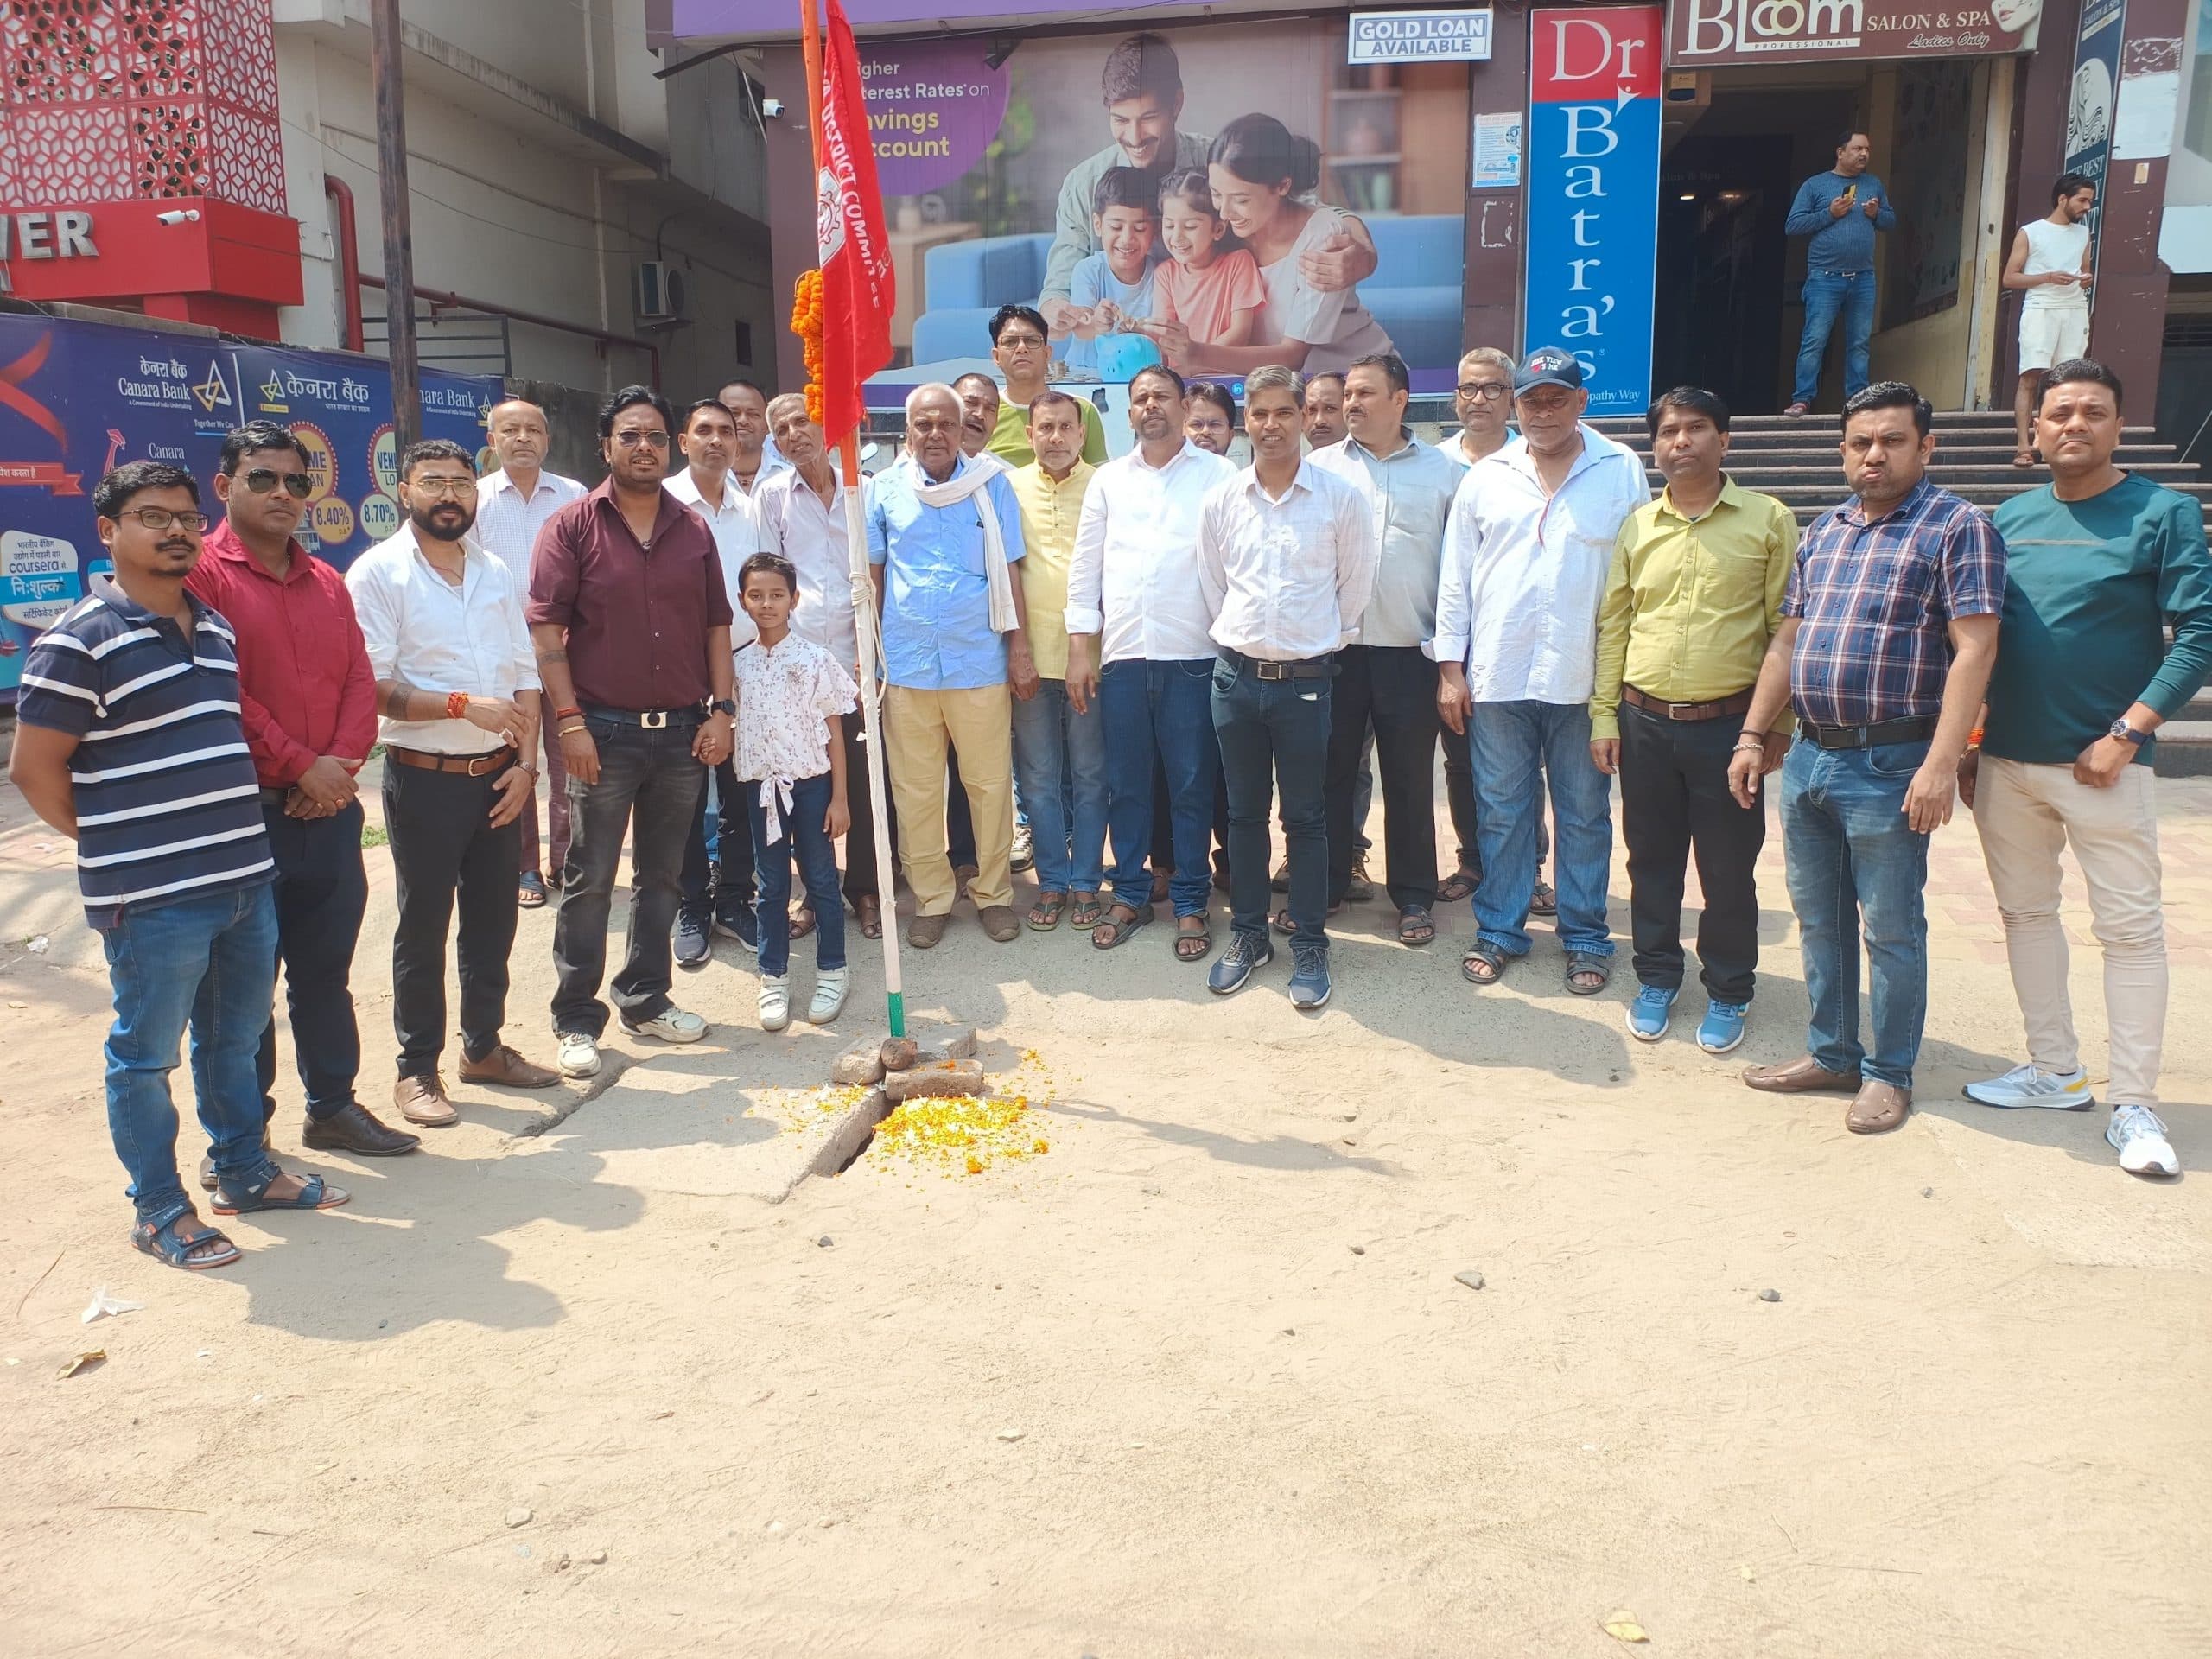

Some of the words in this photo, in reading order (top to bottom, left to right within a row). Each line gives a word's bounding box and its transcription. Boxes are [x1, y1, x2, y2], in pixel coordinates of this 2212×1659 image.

[1359, 21, 1421, 40] GOLD
[1427, 19, 1484, 38] LOAN
[1866, 13, 1931, 31] SALON
[1936, 13, 1951, 29] &
[1956, 10, 1991, 28] SPA
[1371, 39, 1472, 55] AVAILABLE
[1755, 40, 1850, 49] PROFESSIONAL
[1907, 33, 1954, 48] Ladies
[1957, 31, 1990, 48] Only
[969, 84, 990, 97] on
[2083, 154, 2106, 178] BEST
[140, 355, 169, 378] केनरा
[170, 359, 188, 379] बैंक
[118, 378, 161, 398] Canara
[162, 381, 191, 401] Bank
[285, 370, 338, 401] केनरा
[341, 377, 370, 404] बैंक
[447, 388, 475, 409] Bank
[1587, 390, 1618, 404] pathy
[1618, 389, 1641, 403] Way
[194, 419, 216, 429] Together
[149, 442, 185, 460] Canara
[310, 474, 325, 487] AN
[385, 474, 397, 486] LO
[316, 506, 349, 526] 8.40%
[364, 504, 396, 523] 8.70%
[9, 560, 60, 574] coursera
